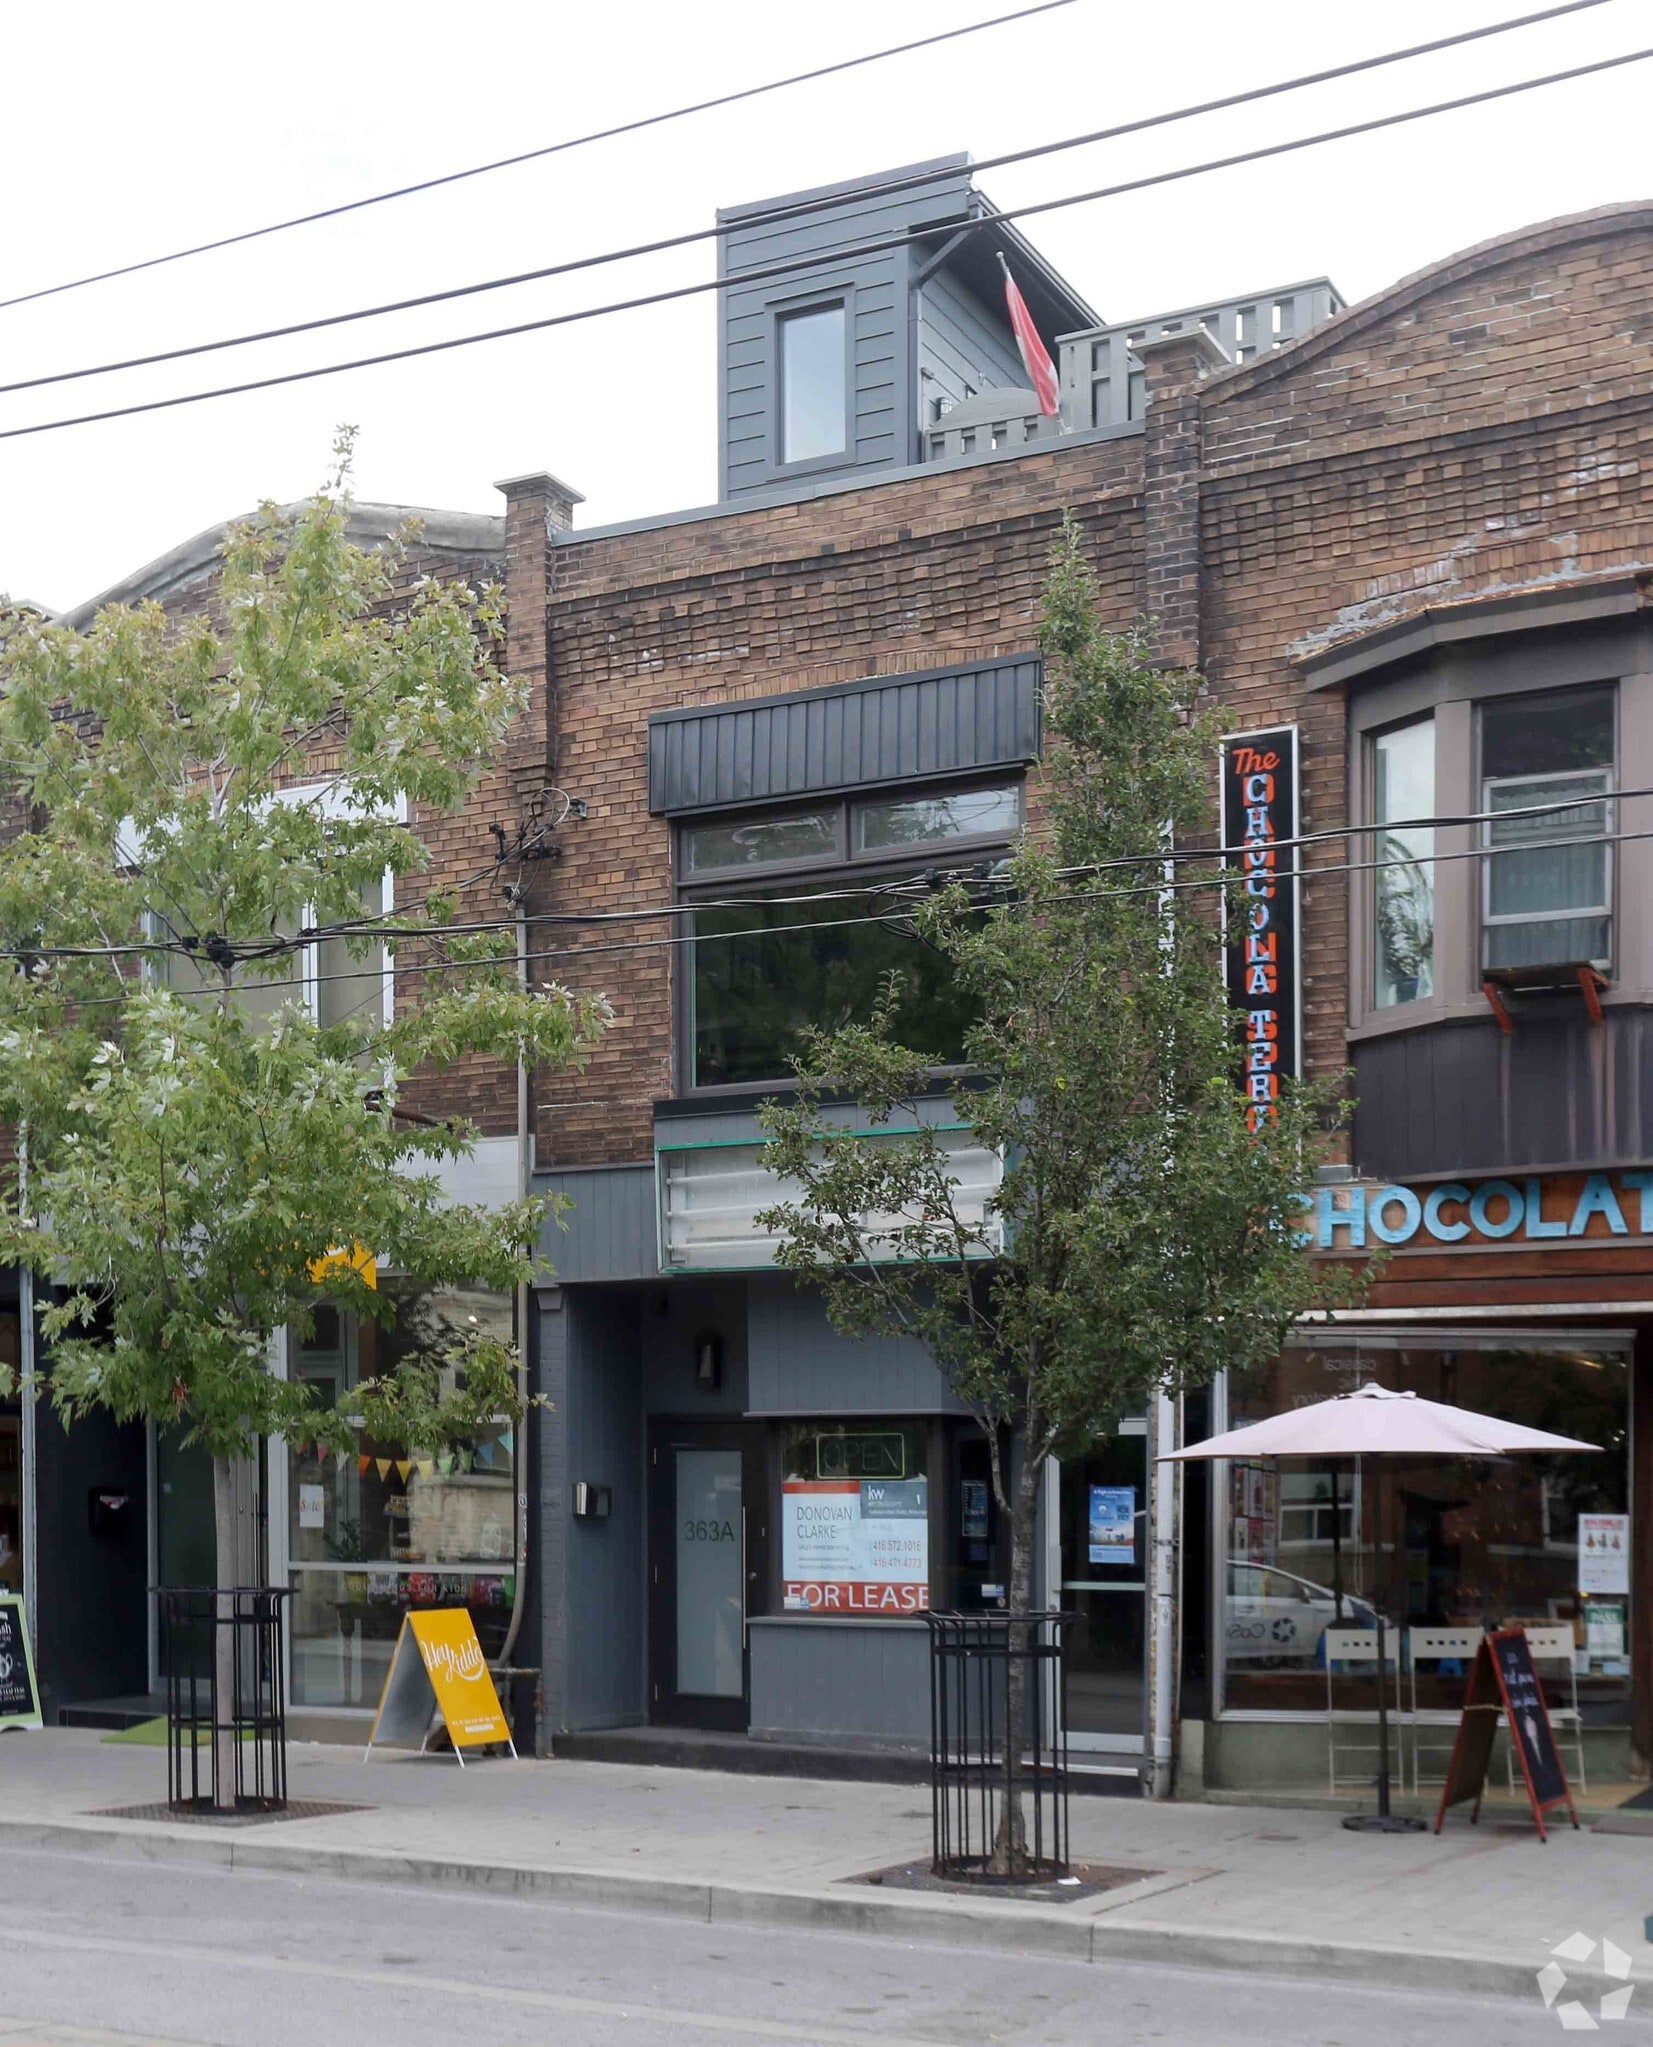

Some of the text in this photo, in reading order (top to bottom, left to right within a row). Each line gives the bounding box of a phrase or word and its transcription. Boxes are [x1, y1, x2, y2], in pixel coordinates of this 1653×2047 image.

[1231, 747, 1280, 775] The
[868, 1484, 885, 1501] kw
[796, 1506, 852, 1521] DONOVAN
[684, 1520, 735, 1542] 363A
[796, 1524, 837, 1539] CLARKE
[787, 1584, 929, 1610] FOR LEASE
